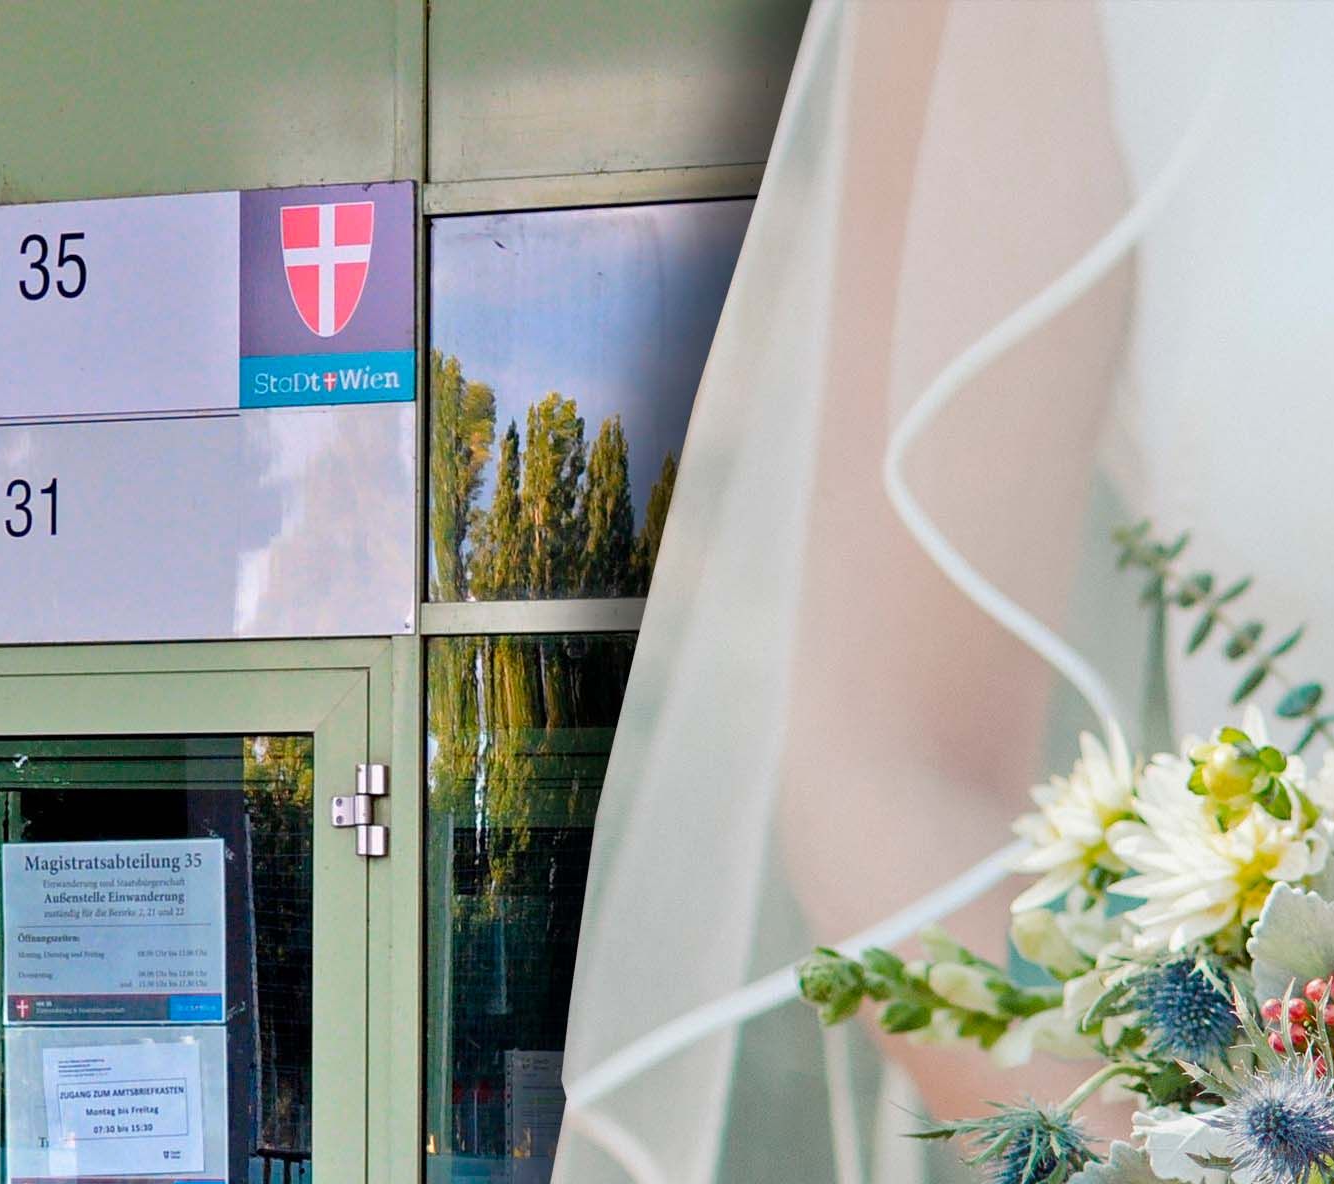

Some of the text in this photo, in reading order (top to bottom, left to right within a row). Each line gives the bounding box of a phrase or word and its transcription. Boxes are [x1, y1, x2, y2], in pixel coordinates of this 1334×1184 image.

[19, 232, 87, 301] 35
[339, 366, 400, 391] Wien
[5, 477, 58, 538] 31
[24, 852, 202, 875] Magistratsabteilung 35
[43, 891, 185, 904] Außenstelle Einwanderung
[59, 1086, 185, 1100] ZUGANG ZUM AMTSBRIEFKASTEN
[85, 1105, 159, 1117] Montag bis Freitag
[117, 1124, 129, 1133] bis
